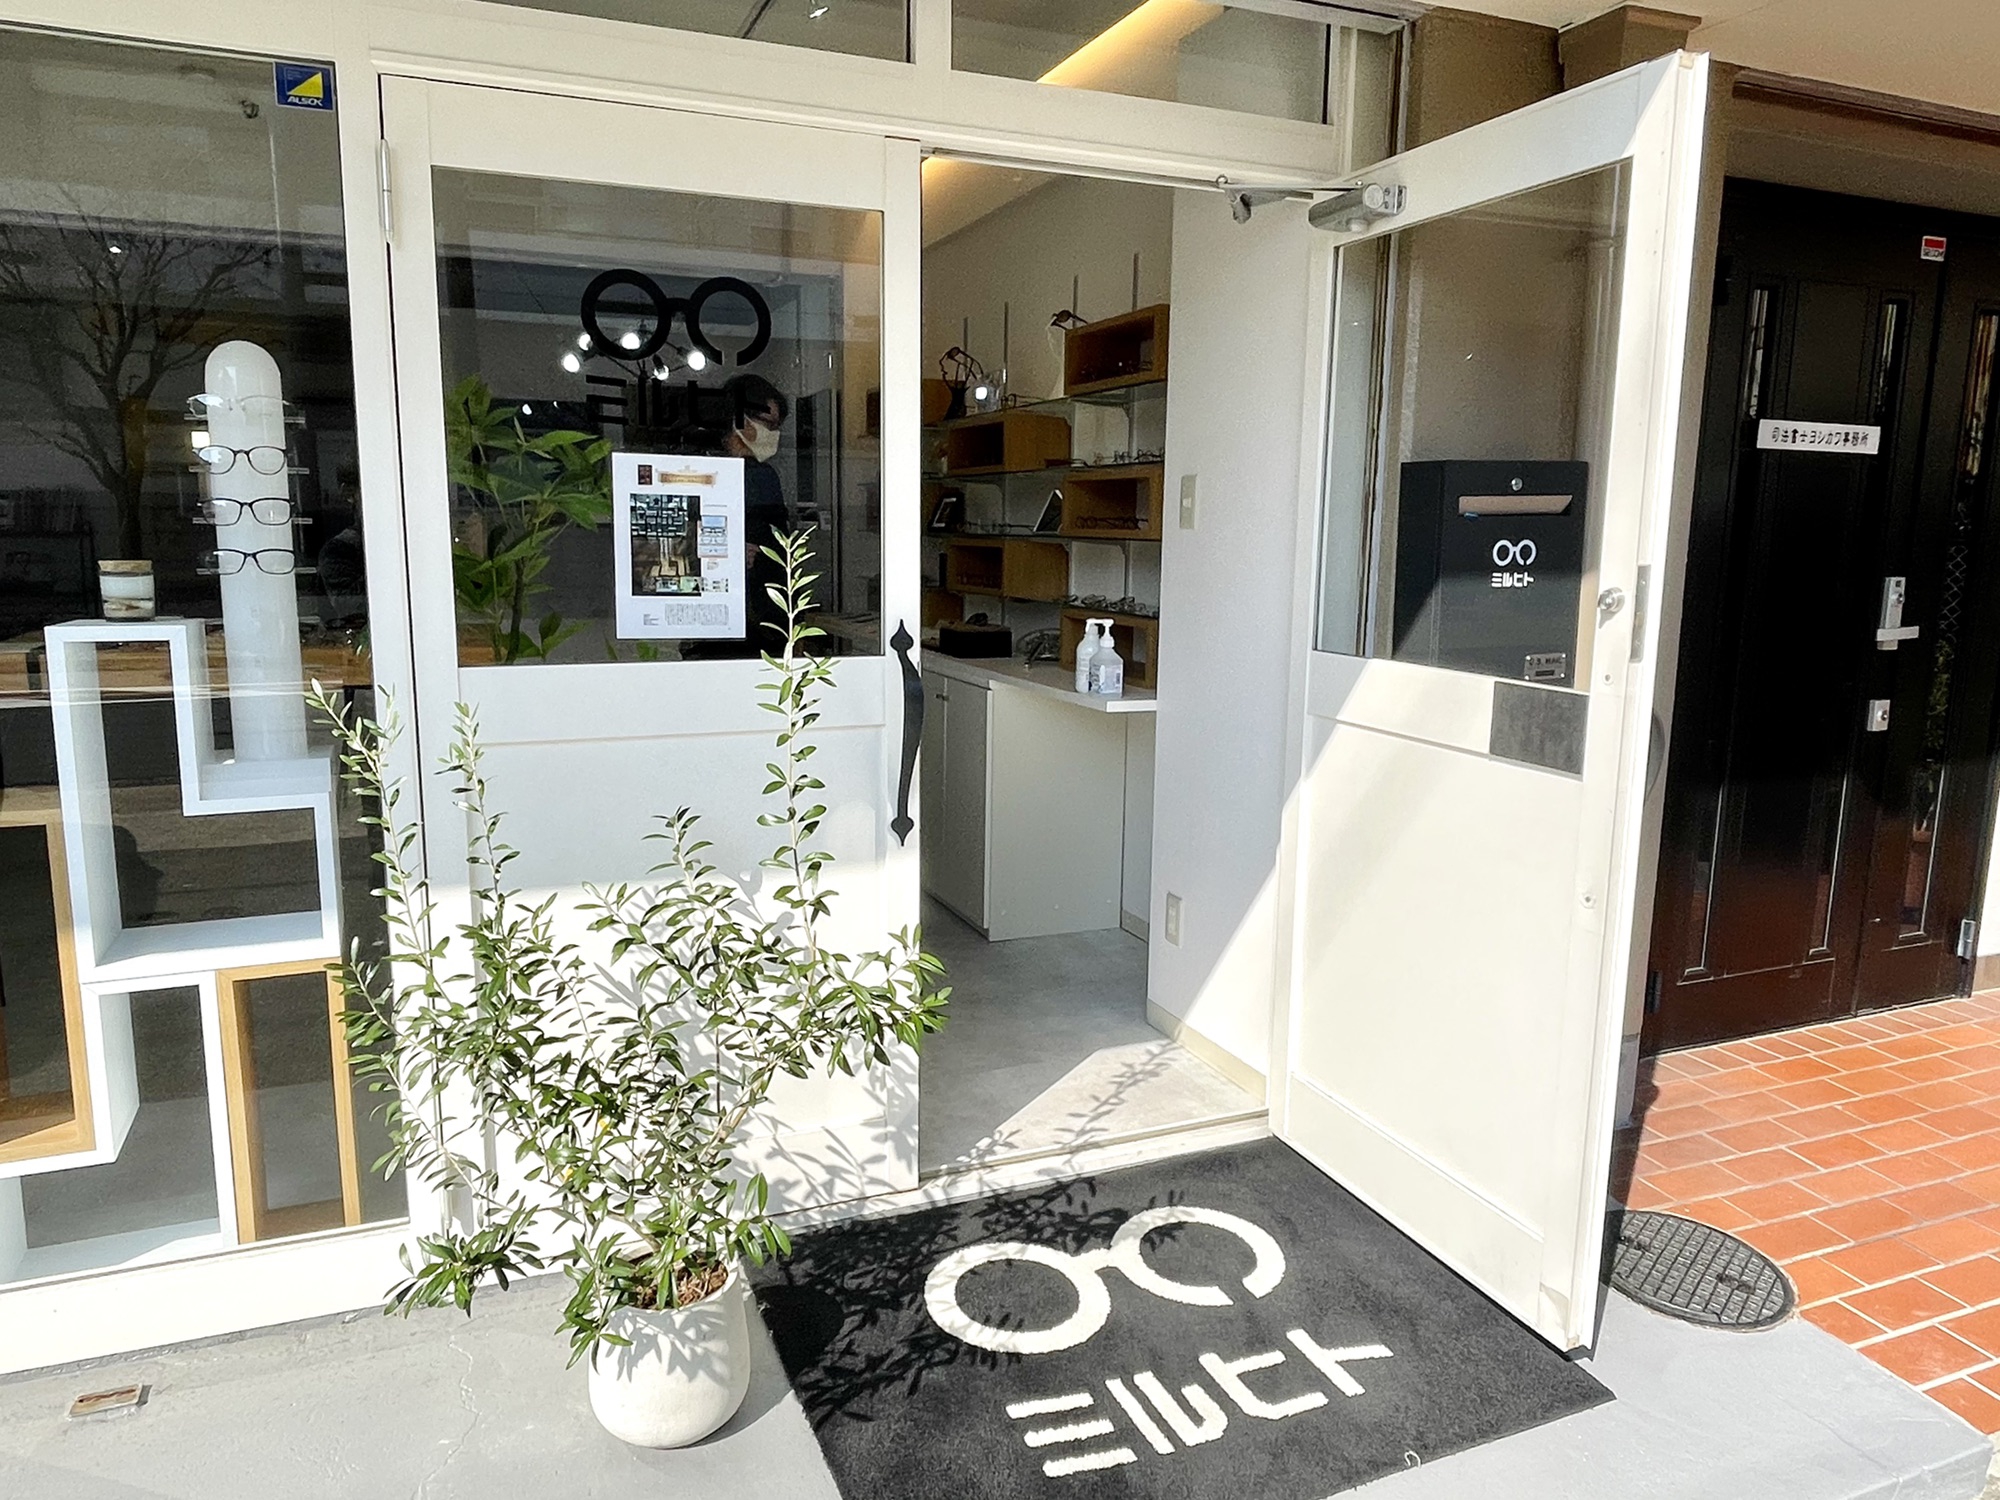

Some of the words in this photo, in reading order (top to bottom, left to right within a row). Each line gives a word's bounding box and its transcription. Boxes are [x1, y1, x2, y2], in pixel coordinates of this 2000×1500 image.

[287, 96, 323, 106] ALSOK
[586, 375, 771, 429] ミルヒト
[1772, 426, 1869, 447] 司法書士ヨシカワ事務所
[1491, 571, 1534, 588] ミルヒト
[1005, 1328, 1394, 1478] ミルヒト
